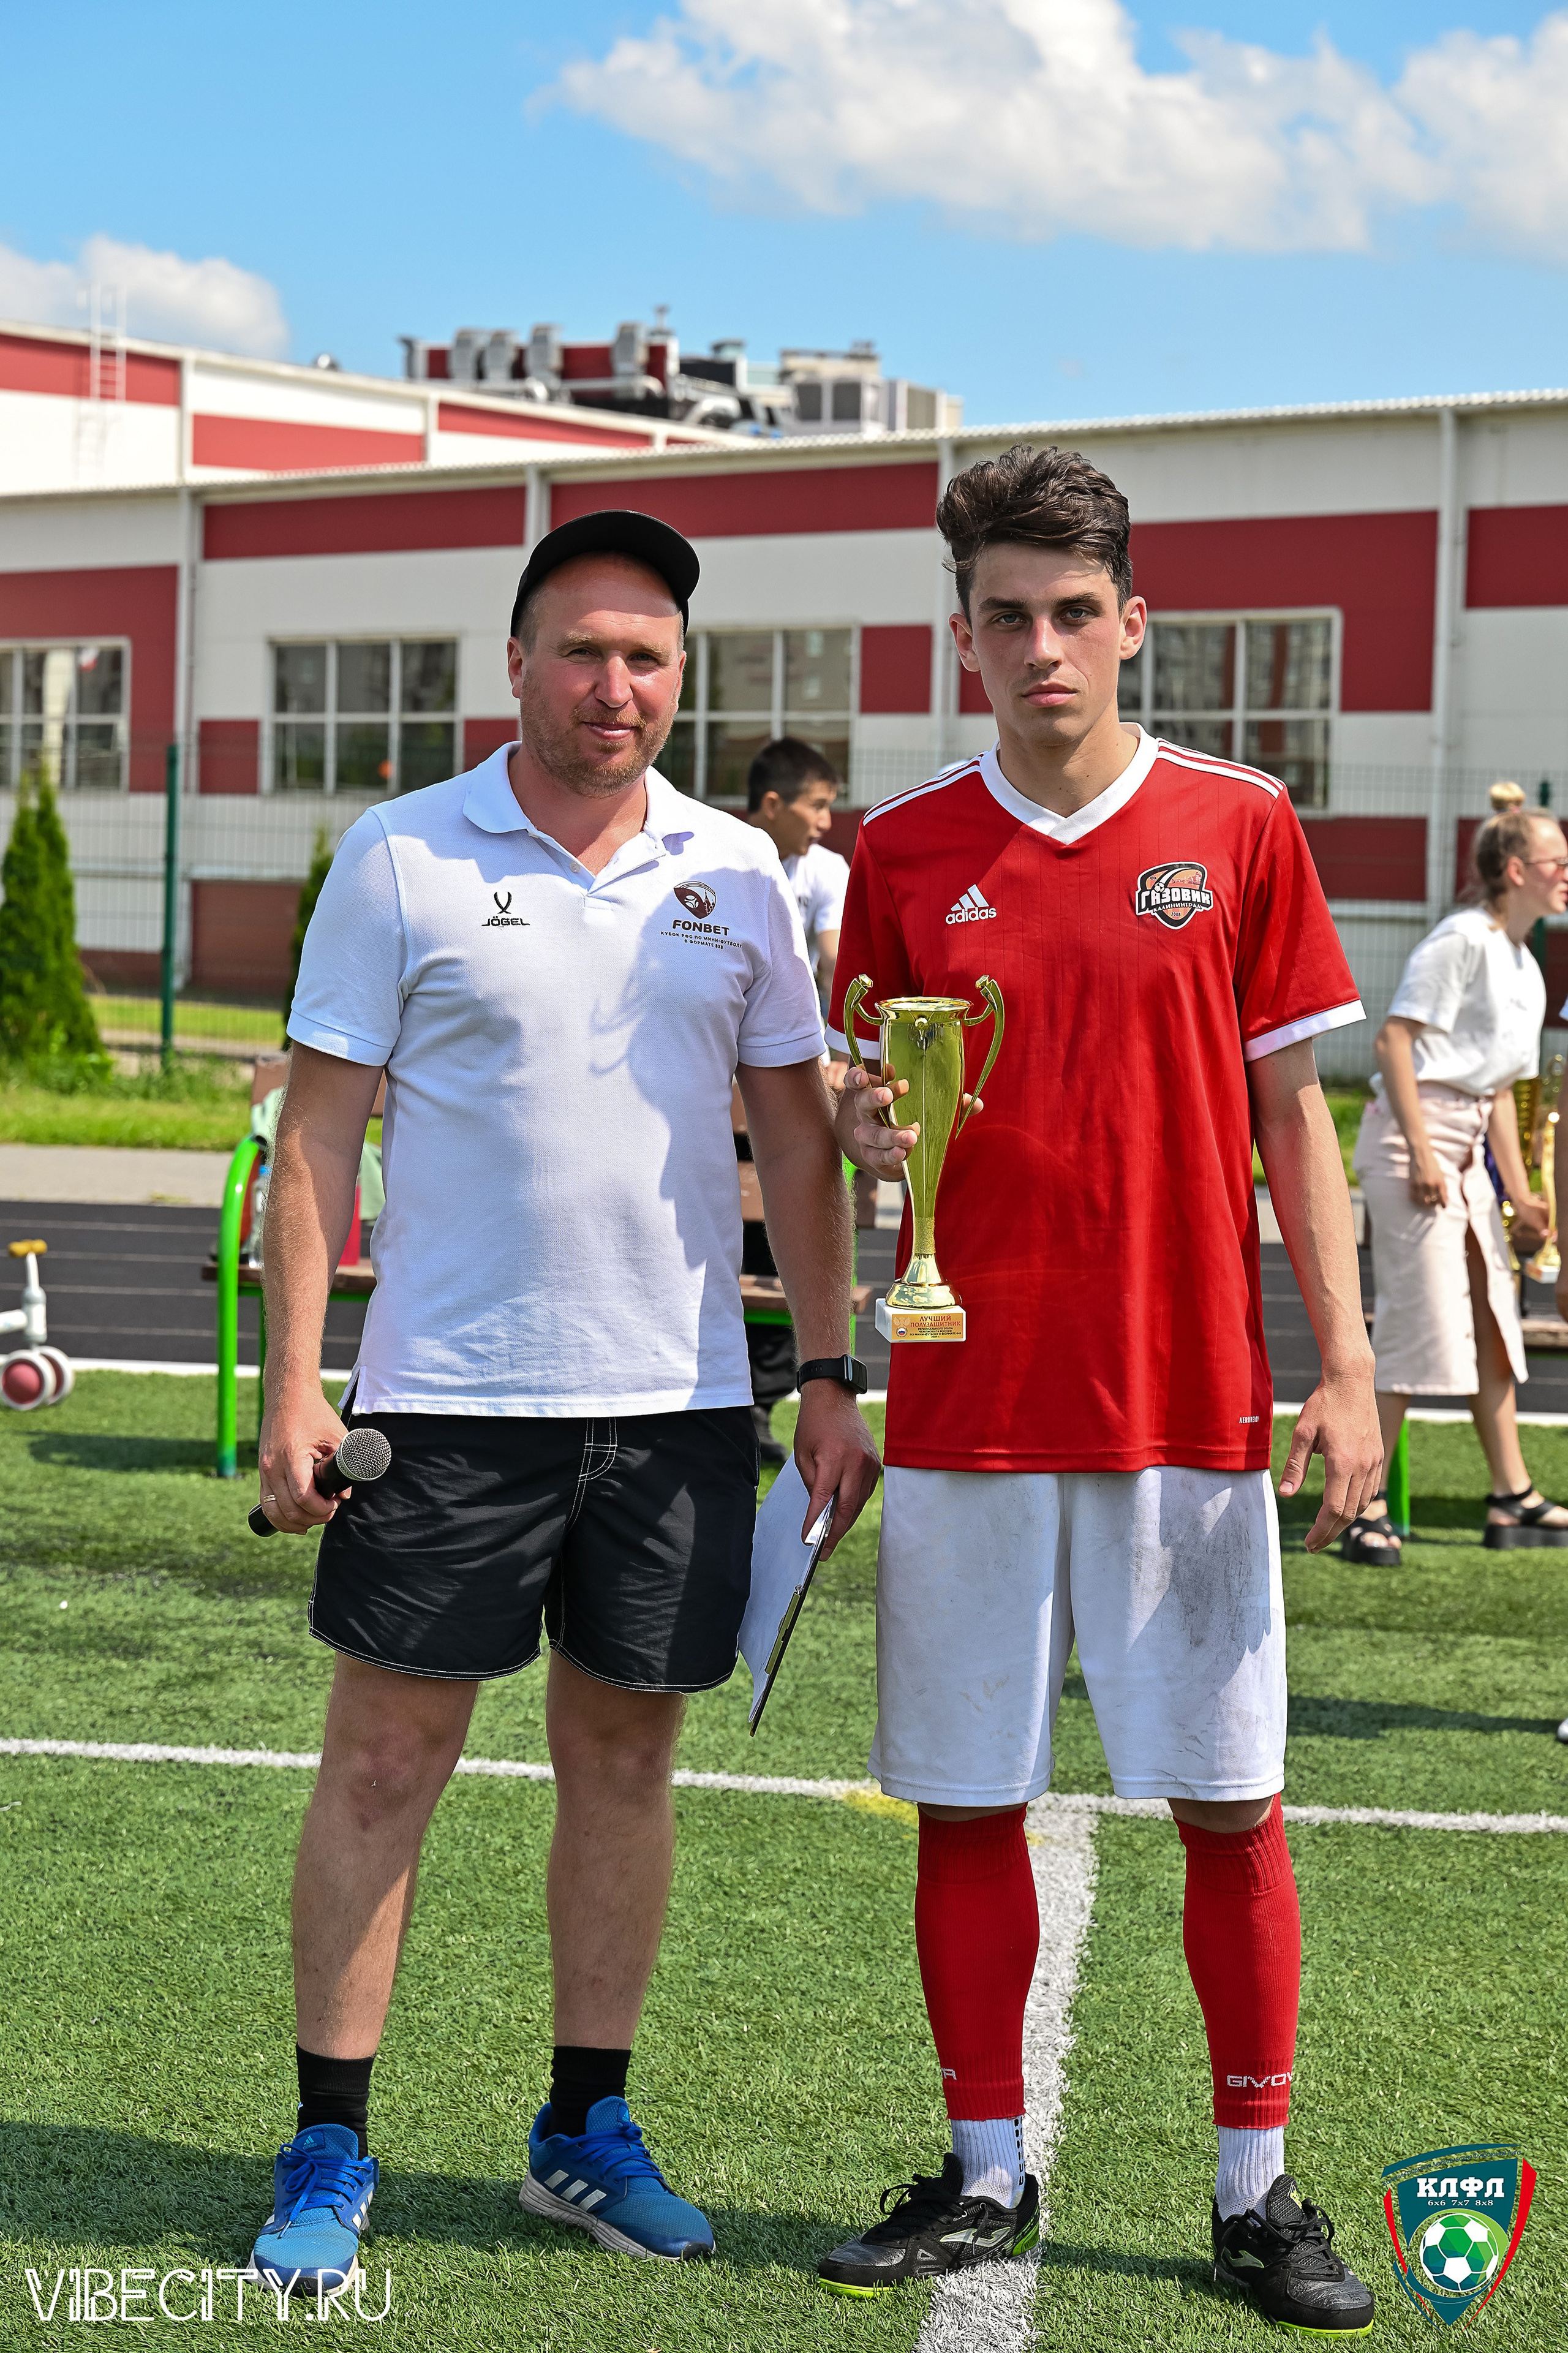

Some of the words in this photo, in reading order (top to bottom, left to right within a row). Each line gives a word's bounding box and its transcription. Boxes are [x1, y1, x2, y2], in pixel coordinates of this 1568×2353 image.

[1141, 888, 1211, 909] ГАЗОВИК
[1153, 902, 1202, 913] КАЛИНИНГРАД
[481, 915, 530, 926] JÖGEL
[945, 907, 997, 924] adidas
[673, 920, 730, 936] FONBET
[703, 937, 742, 949] МИНИ-ФУТБОЛУ
